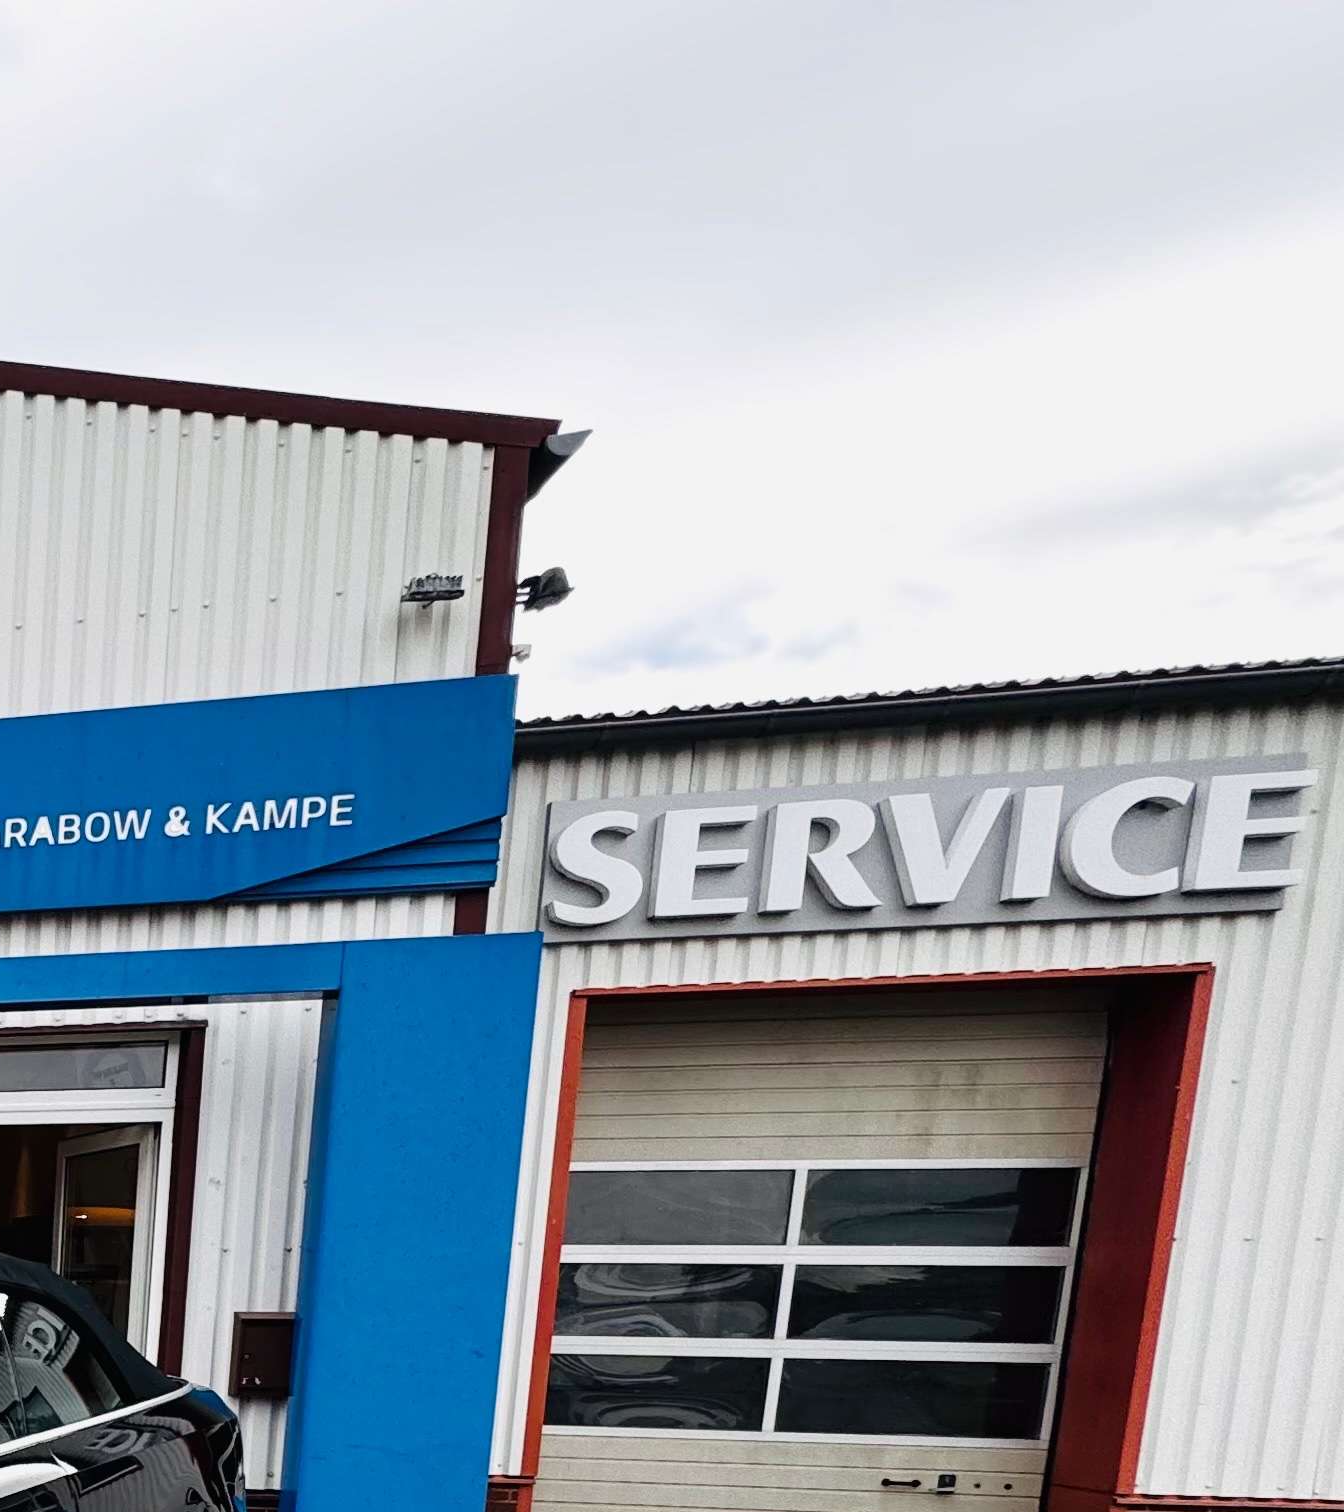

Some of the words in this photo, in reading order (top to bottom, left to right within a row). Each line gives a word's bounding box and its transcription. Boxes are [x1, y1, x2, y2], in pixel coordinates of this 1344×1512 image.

[164, 806, 192, 838] &
[204, 793, 357, 835] KAMPE
[543, 769, 1319, 927] SERVICE
